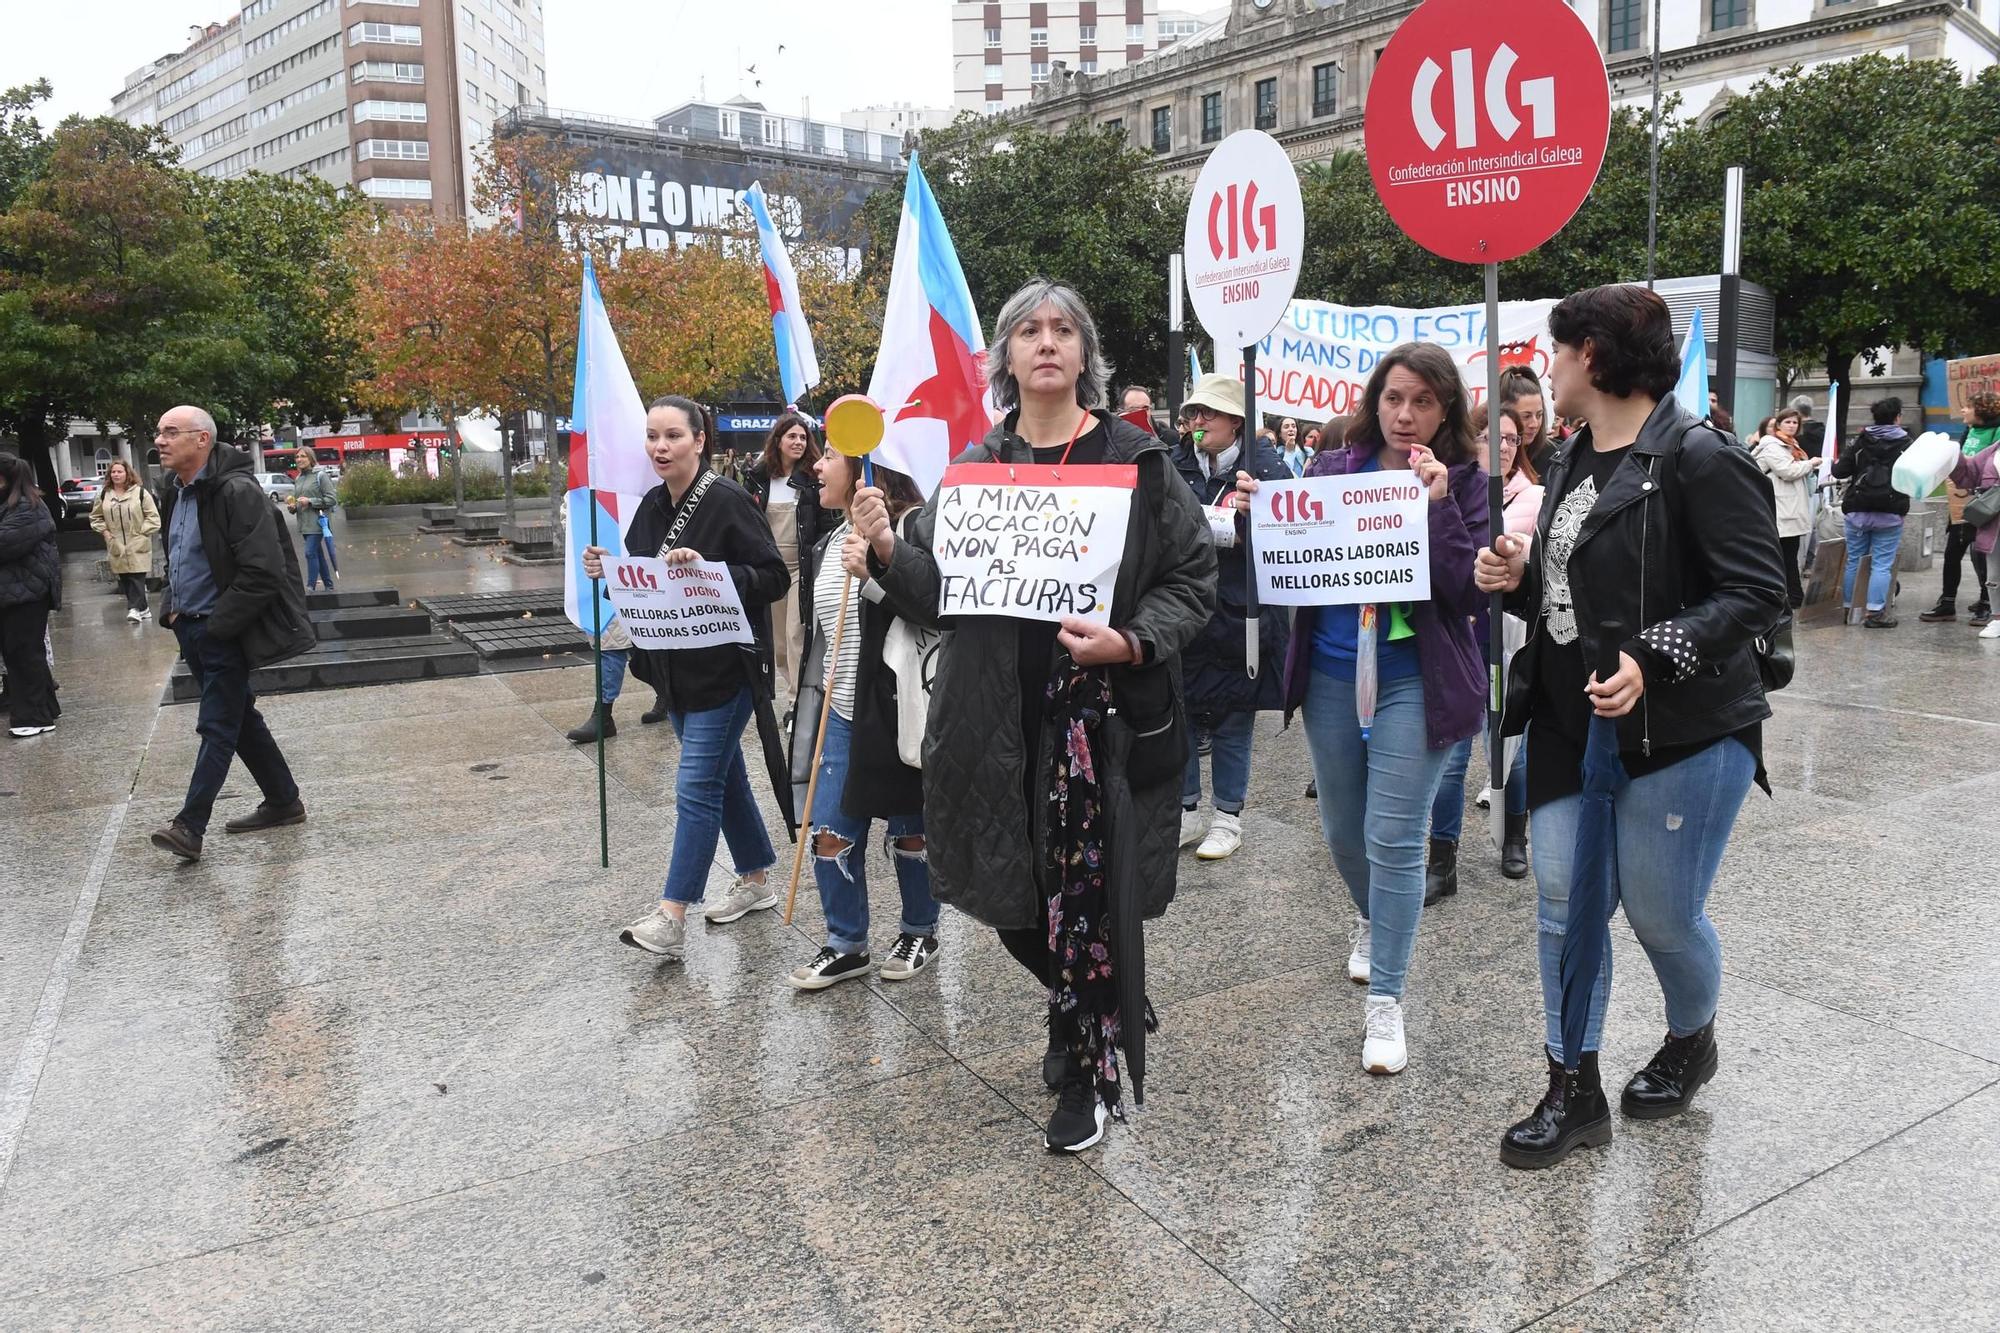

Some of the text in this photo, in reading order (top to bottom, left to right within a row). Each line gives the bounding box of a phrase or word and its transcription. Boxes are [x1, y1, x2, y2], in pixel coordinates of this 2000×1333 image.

[1411, 42, 1556, 152] CIG
[1388, 146, 1583, 182] Confederación Intersindical Galega
[636, 170, 658, 224] É
[661, 181, 687, 226] O
[1446, 175, 1521, 207] ENSINO
[1207, 179, 1277, 262] CIG
[1195, 256, 1291, 286] Confederación Intersindical Galega
[1222, 280, 1260, 304] ENSINO
[1283, 307, 1399, 343] UTURO
[1282, 337, 1351, 369] MANS
[343, 436, 365, 450] arenal
[943, 487, 962, 510] A
[1271, 489, 1324, 523] CIG
[1342, 486, 1420, 506] CONVENIO
[1357, 514, 1403, 532] DIGNO
[945, 534, 1079, 562] NON PAGA
[1262, 540, 1421, 565] MELLORAS LABORAIS
[617, 565, 658, 590] CIG
[667, 567, 724, 582] CONVENIO
[987, 558, 1017, 576] AS
[1271, 568, 1414, 590] MELLORAS SOCIAIS
[684, 586, 721, 598] DIGNO
[620, 604, 740, 620] MELLORAS LABORAIS
[630, 621, 741, 638] MELLORAS SOCIAIS
